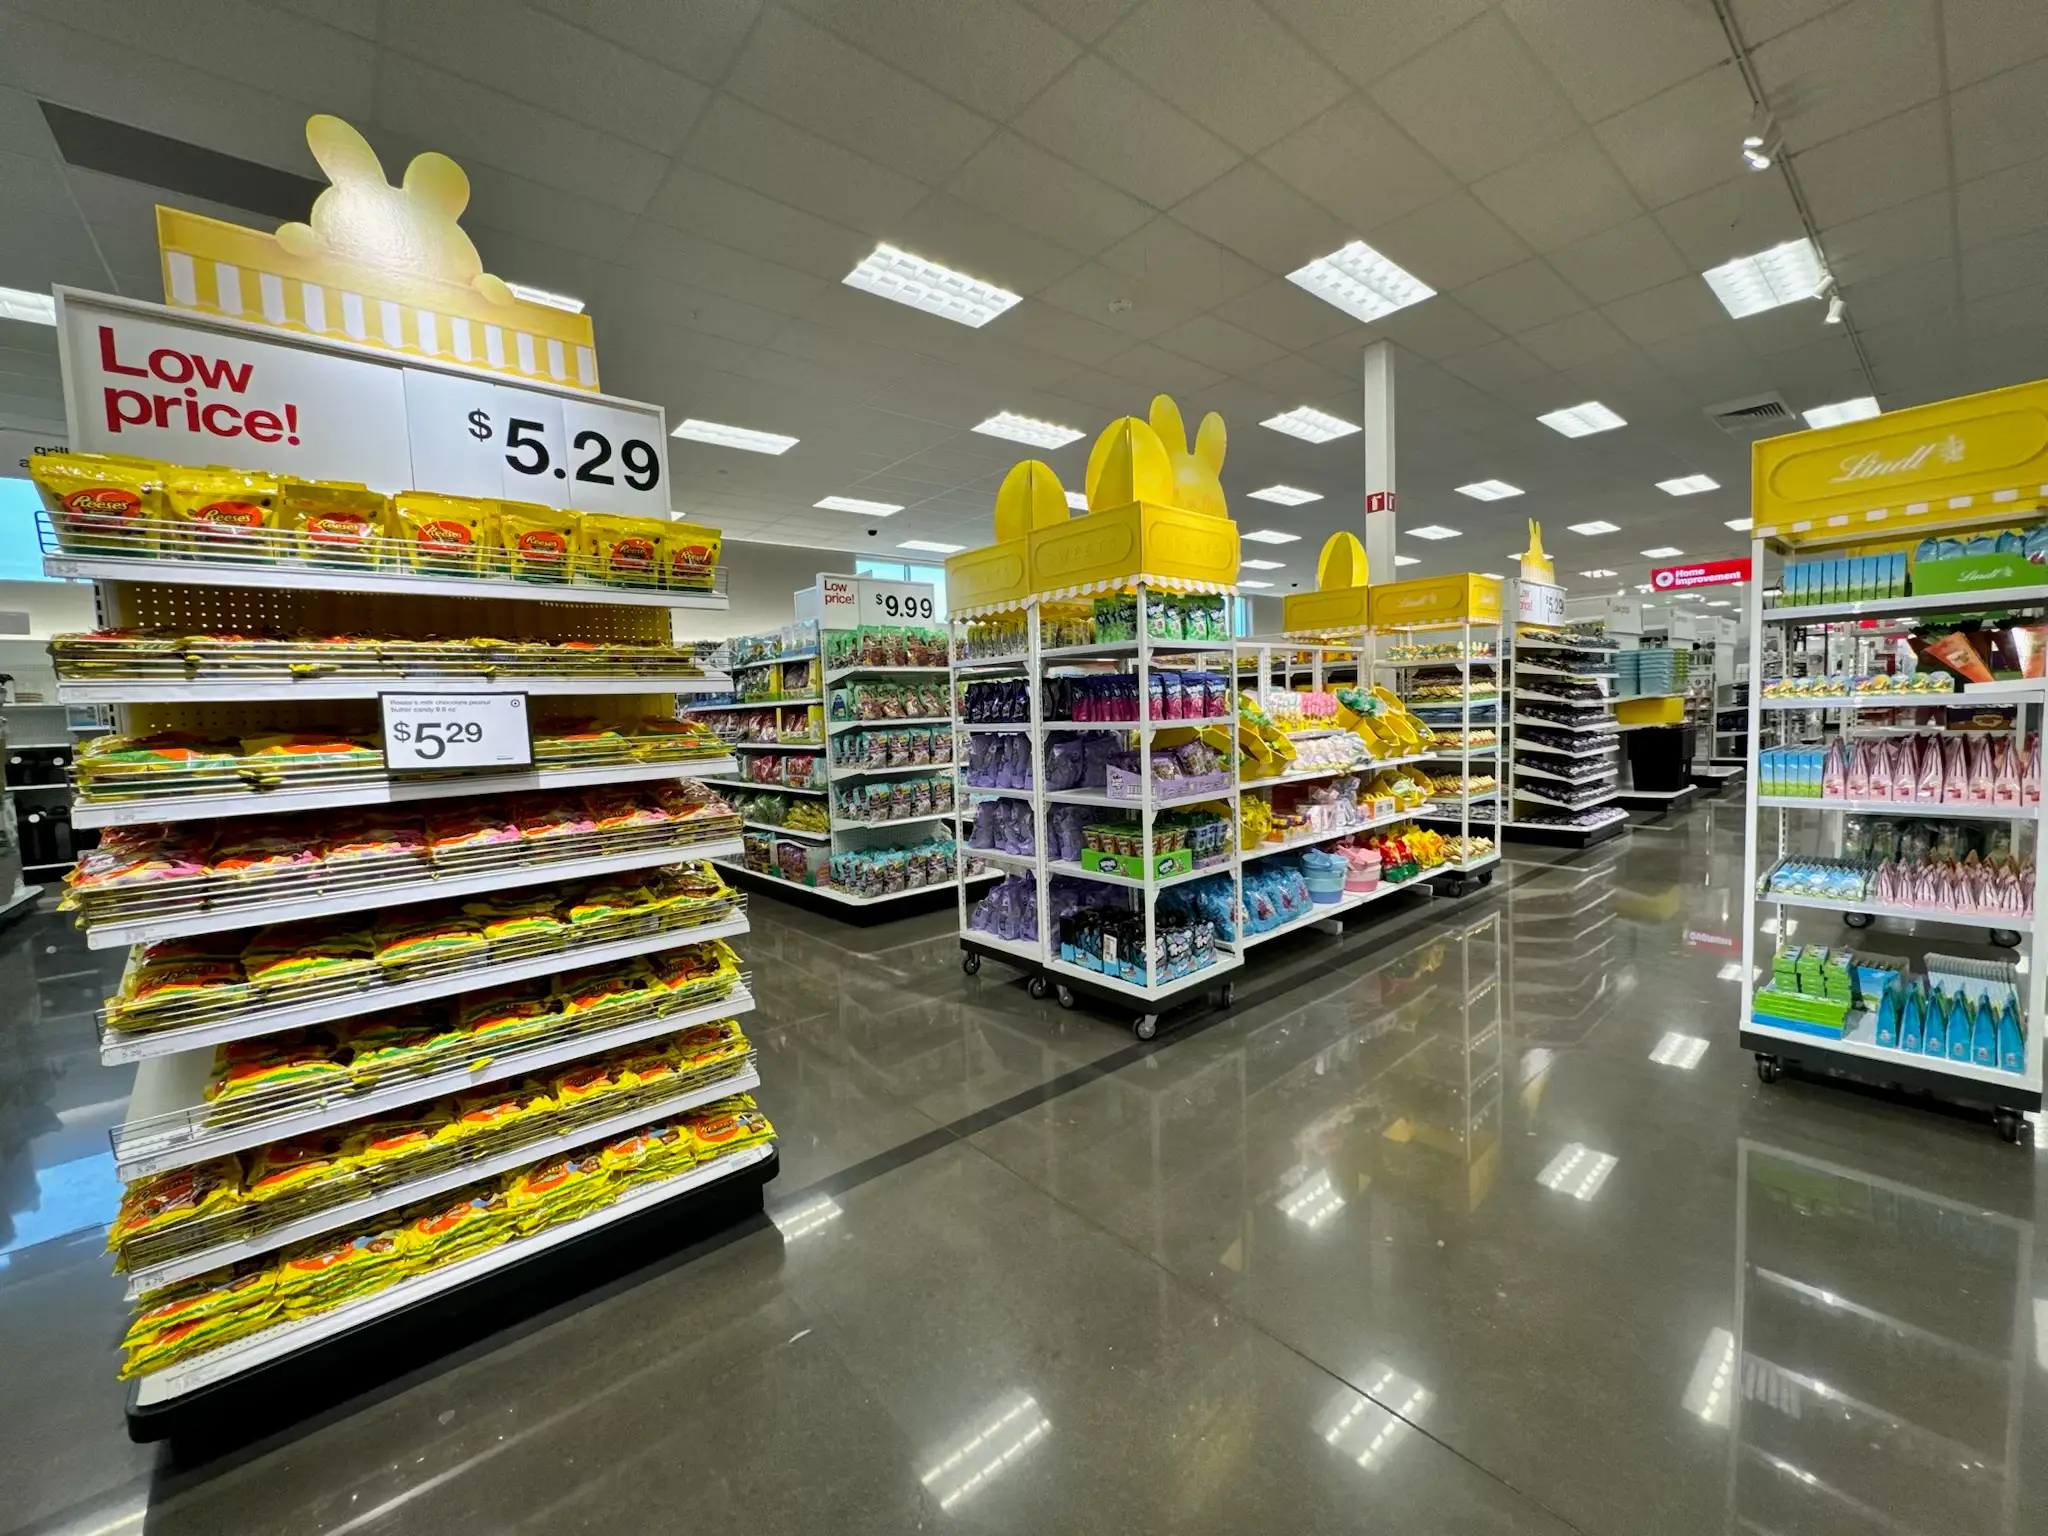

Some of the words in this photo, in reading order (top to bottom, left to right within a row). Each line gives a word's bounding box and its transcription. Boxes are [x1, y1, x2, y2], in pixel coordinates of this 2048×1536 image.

[98, 325, 254, 393] Low
[104, 387, 301, 446] price!
[467, 407, 661, 492] $5.29
[1828, 441, 1937, 484] Lindt
[823, 579, 848, 592] Low
[1675, 568, 1705, 577] Home
[1675, 571, 1742, 586] Improvement
[824, 592, 855, 605] price!
[875, 593, 933, 619] $9.99
